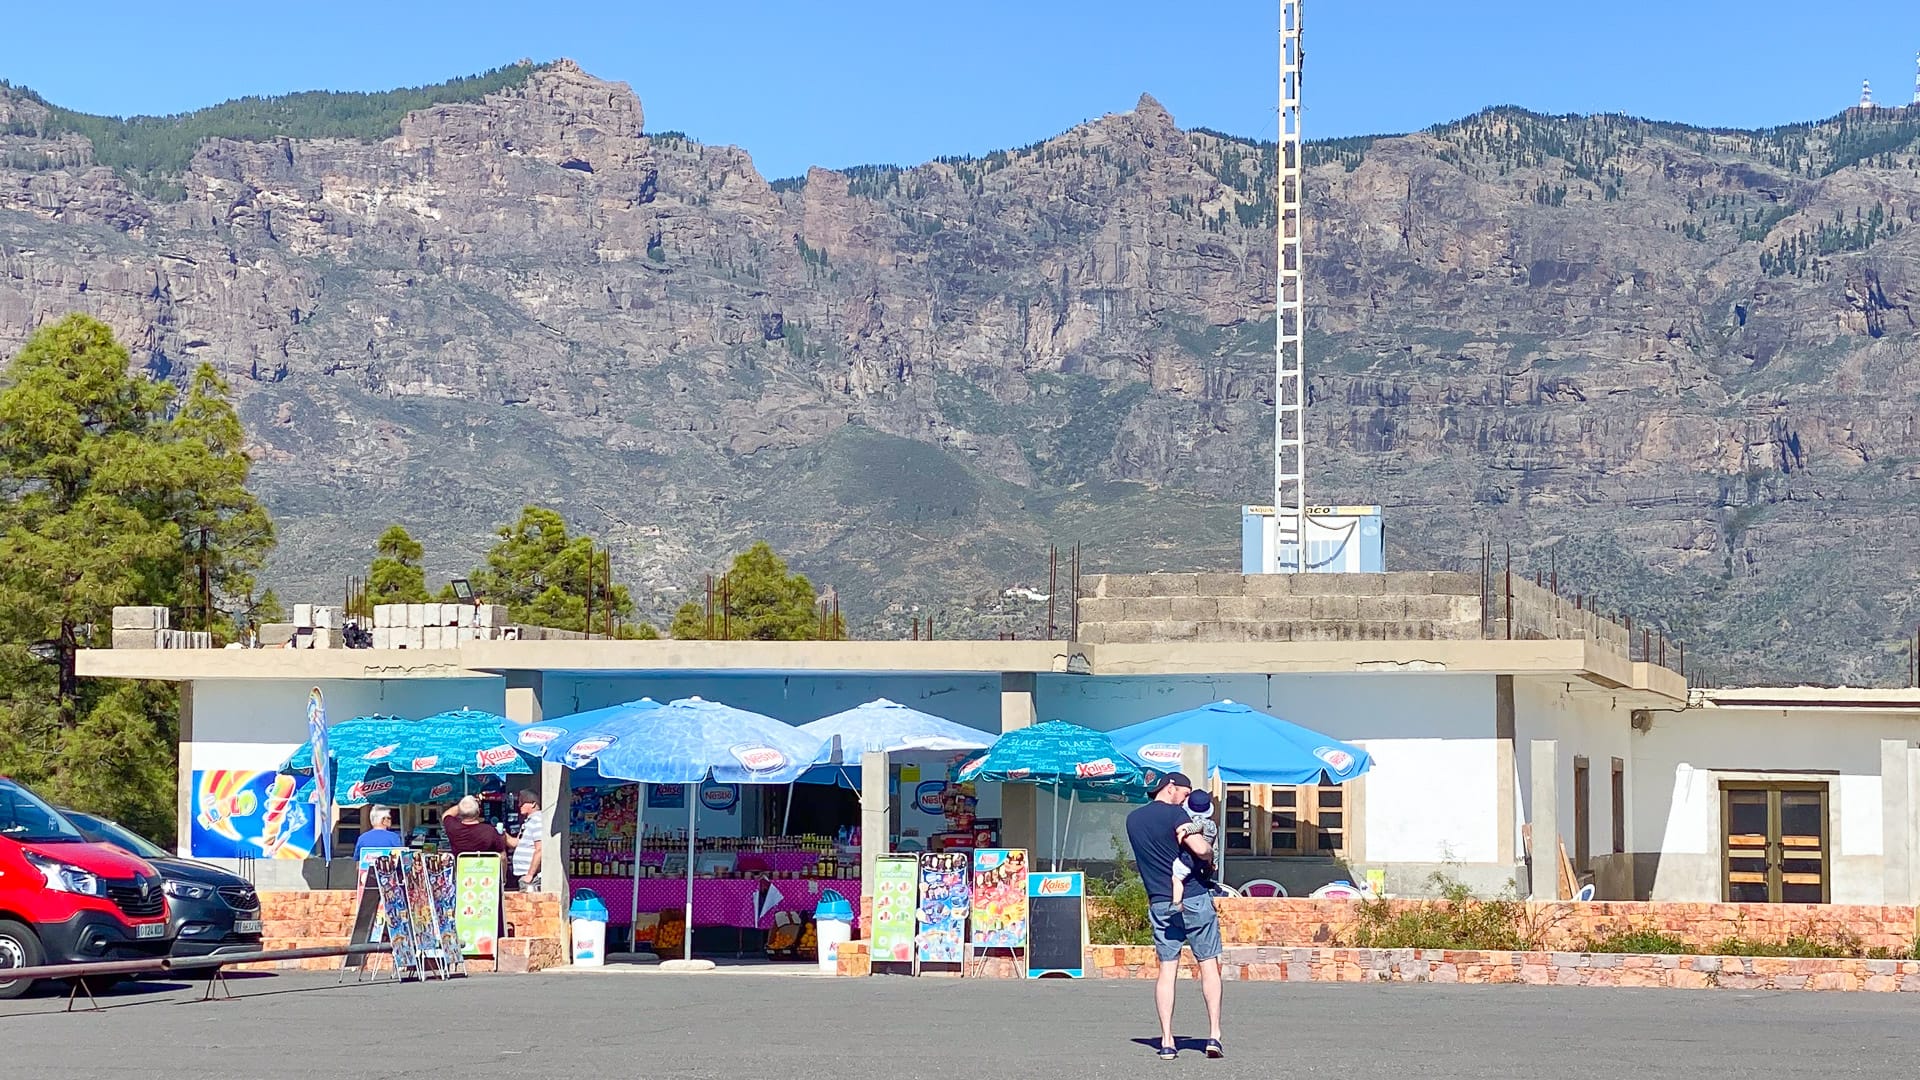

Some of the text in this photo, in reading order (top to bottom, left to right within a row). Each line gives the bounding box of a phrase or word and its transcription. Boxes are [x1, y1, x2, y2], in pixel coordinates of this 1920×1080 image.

[478, 749, 517, 768] Kalise
[1078, 763, 1115, 778] Kalise
[353, 781, 393, 801] Kalise
[1042, 877, 1070, 893] Kalise
